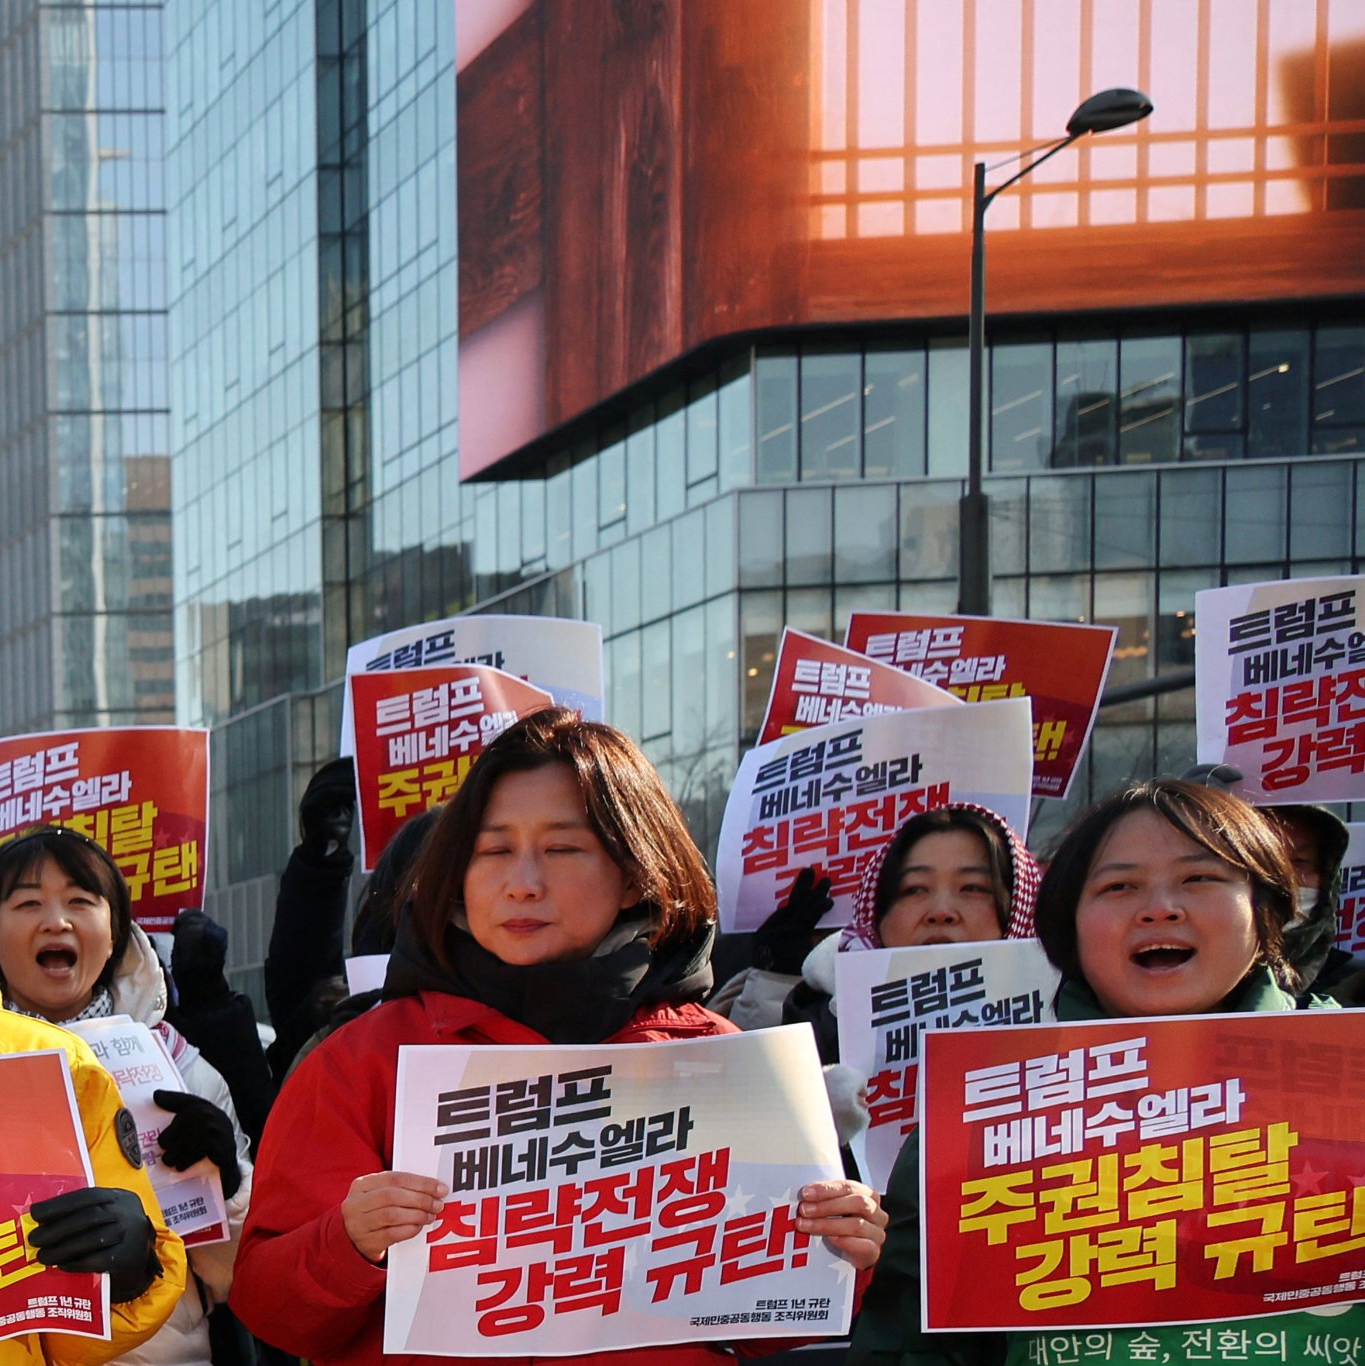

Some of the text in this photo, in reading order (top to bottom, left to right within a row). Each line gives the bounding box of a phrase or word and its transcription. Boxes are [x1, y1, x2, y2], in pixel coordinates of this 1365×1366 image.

[1228, 590, 1356, 655] 트럼프
[376, 676, 484, 736] 트럼프
[792, 659, 871, 699] 트럼프
[378, 756, 478, 818] 주권
[752, 728, 863, 795] 트럼프
[759, 753, 923, 821] 베네수엘라
[871, 958, 986, 1028] 트럼프
[434, 1065, 612, 1146] 트럼프
[963, 1036, 1149, 1124] 트럼프
[453, 1106, 694, 1192] 베네수엘라
[983, 1079, 1246, 1169] 베네수엘라
[426, 1147, 730, 1273] 침략전쟁
[959, 1121, 1299, 1246] 주권침탈
[475, 1203, 810, 1337] 강력 규탄!
[1015, 1186, 1365, 1312] 강력 규탄
[28, 1296, 57, 1308] 트럼프
[73, 1297, 92, 1310] 규탄
[755, 1298, 830, 1311] 트럼프 1년 규탄
[774, 1310, 829, 1322] 조직위원회
[1029, 1328, 1363, 1366] 대안의 숲, 전환의 씨앗
